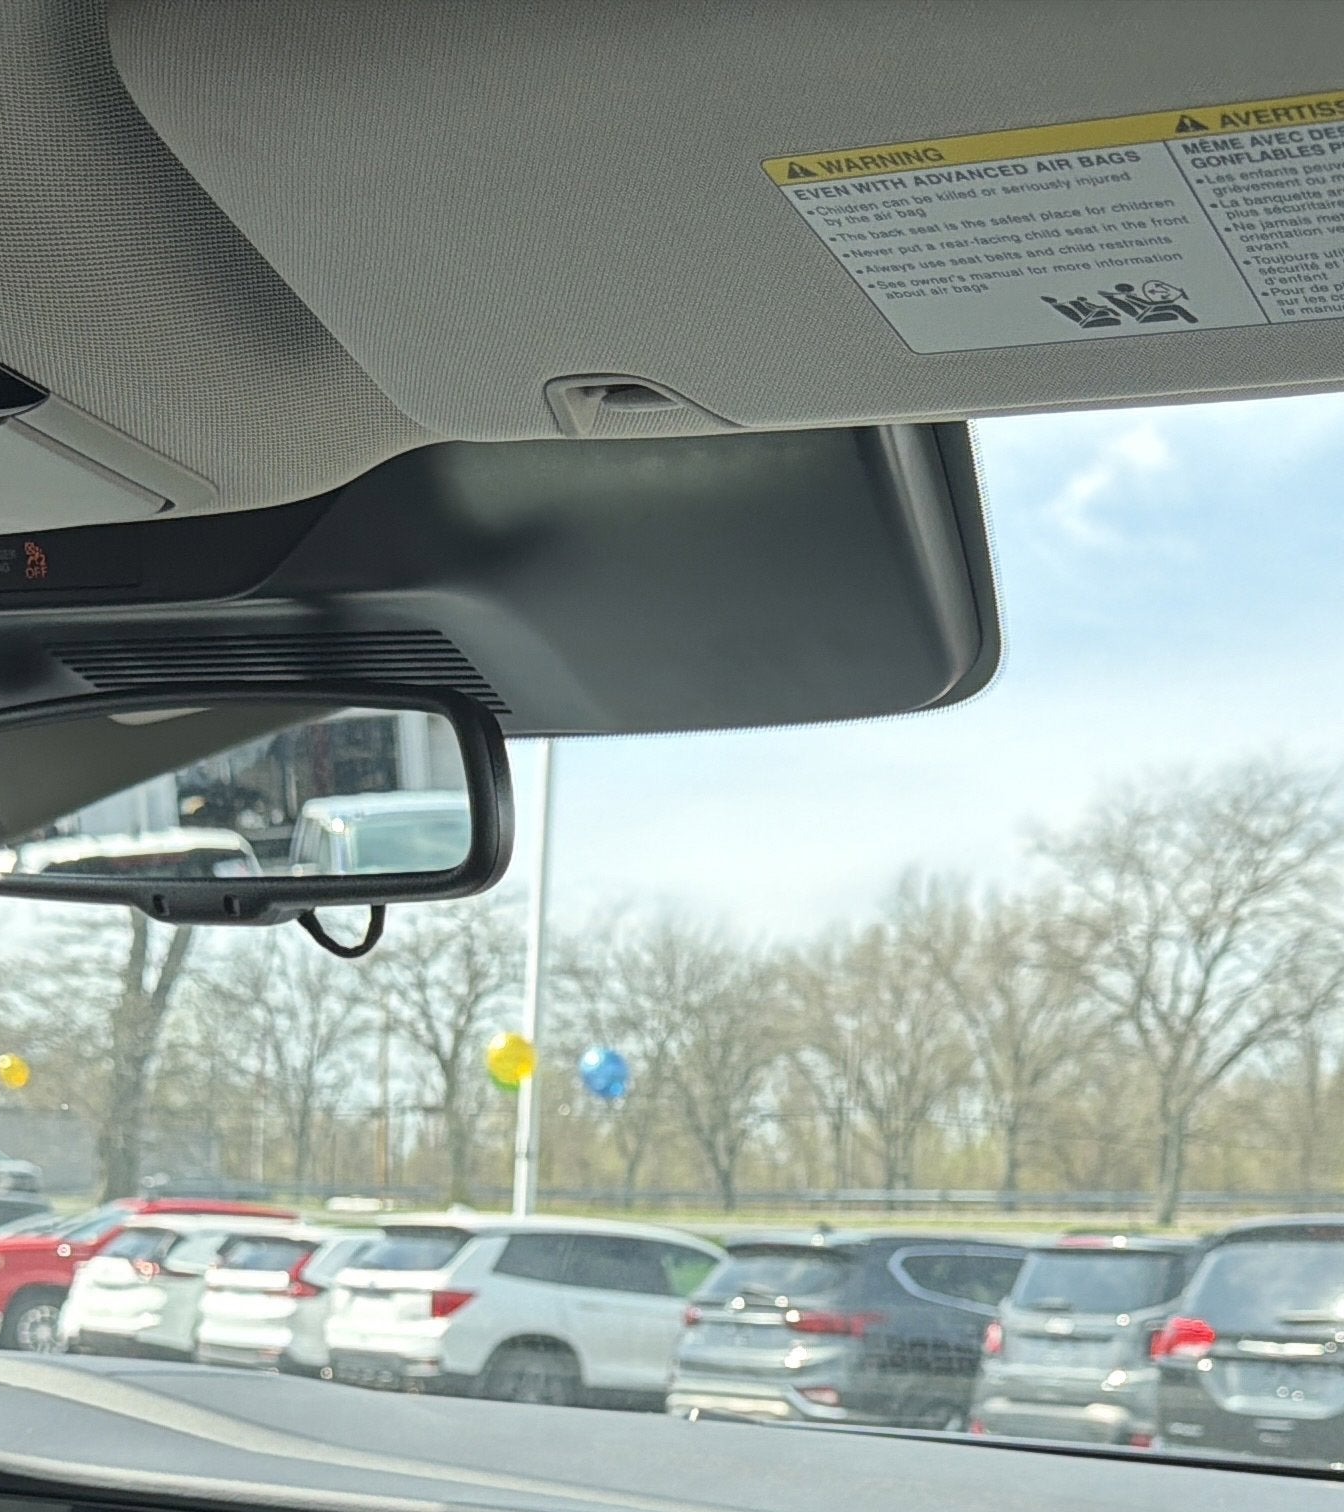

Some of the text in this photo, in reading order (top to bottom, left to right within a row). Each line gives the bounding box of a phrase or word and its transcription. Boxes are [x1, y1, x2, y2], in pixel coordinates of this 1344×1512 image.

[1250, 130, 1305, 148] AVEC
[816, 147, 946, 175] WARNING
[1190, 143, 1326, 170] GONFLABLES
[792, 150, 1142, 201] EVEN WITH ADVANCED AIR BAGS
[814, 170, 1133, 217] Children can be killed or seriously injured
[25, 567, 48, 579] OFF
